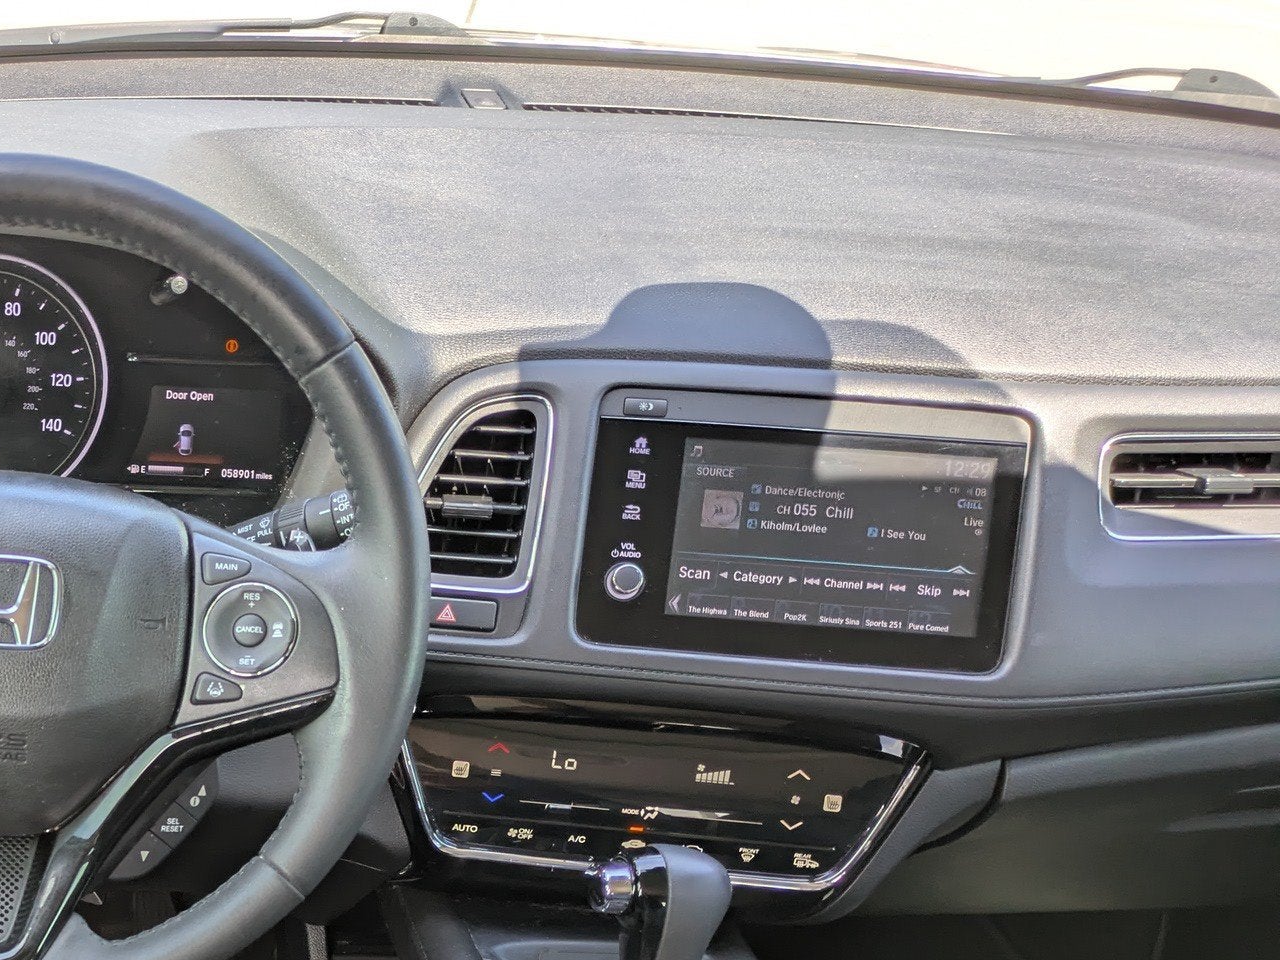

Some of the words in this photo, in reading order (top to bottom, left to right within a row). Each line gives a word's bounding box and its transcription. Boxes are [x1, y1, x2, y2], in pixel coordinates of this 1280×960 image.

[4, 302, 21, 316] 80
[34, 331, 56, 345] 100
[50, 373, 72, 387] 120
[27, 385, 39, 393] 200
[166, 390, 187, 400] Door
[190, 391, 214, 401] Open
[40, 418, 62, 432] 140
[629, 447, 650, 455] HOME
[140, 465, 146, 473] E
[204, 468, 210, 476] F
[696, 466, 735, 478] SOURCE
[944, 460, 991, 479] 12:29
[221, 469, 255, 479] 058901
[255, 472, 273, 480] miles
[625, 481, 646, 489] MENU
[765, 485, 846, 500] Dance/Electronic
[974, 487, 987, 497] 08
[776, 505, 791, 515] CH
[793, 503, 817, 516] 055
[825, 506, 854, 519] Chill
[622, 513, 641, 521] BACK
[964, 517, 984, 527] Live
[237, 524, 253, 535] MIST
[257, 528, 273, 538] PULL
[887, 529, 905, 539] See
[908, 531, 926, 541] You
[621, 542, 636, 550] VOL
[619, 550, 642, 559] AUDIO
[215, 563, 238, 571] MAIN
[678, 566, 711, 580] Scan
[733, 570, 783, 586] Category
[824, 578, 863, 590] Channel
[917, 584, 941, 598] Skip
[243, 592, 260, 601] RES
[688, 605, 700, 613] The
[702, 606, 727, 616] Highwa
[734, 609, 747, 617] The
[749, 610, 769, 619] Blend
[783, 612, 807, 622] Pop2K
[865, 619, 888, 629] Sports
[889, 621, 902, 629] 251
[908, 622, 925, 631] Pure
[926, 624, 949, 633] Comed
[235, 625, 263, 634] CANCEL
[239, 658, 255, 666] SET
[551, 750, 578, 770] Lo
[166, 817, 180, 825] SEL
[160, 825, 184, 833] RESET
[452, 823, 478, 833] AUTO
[568, 834, 587, 844] A/C
